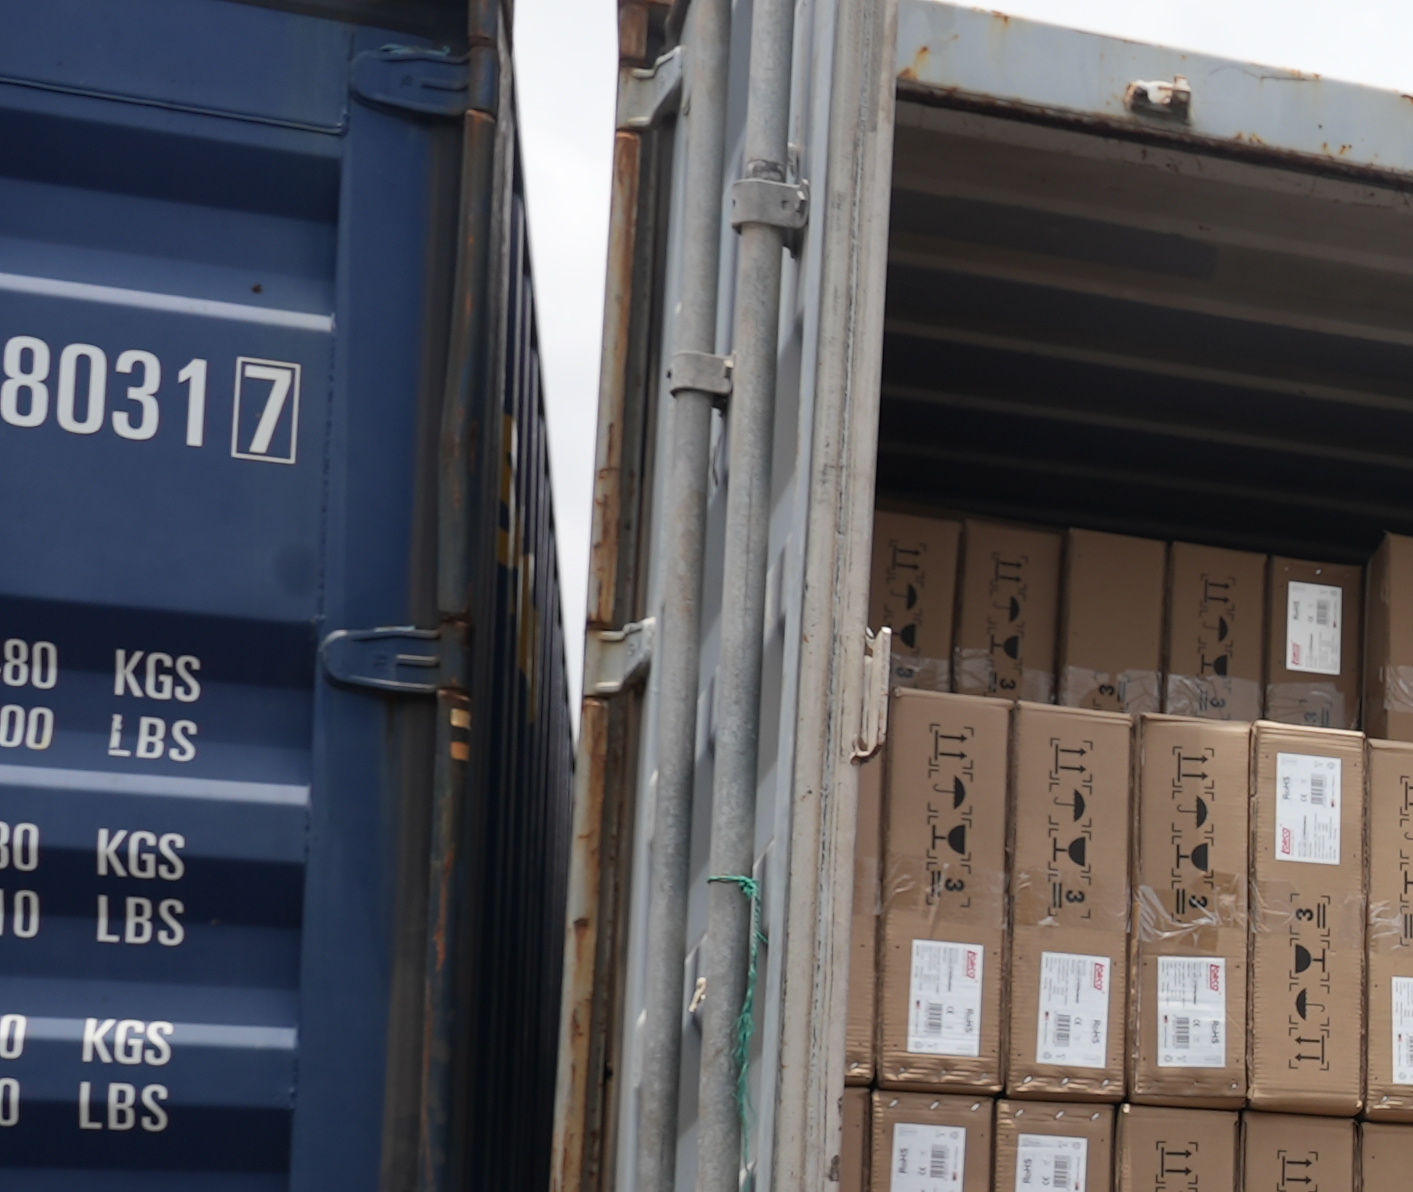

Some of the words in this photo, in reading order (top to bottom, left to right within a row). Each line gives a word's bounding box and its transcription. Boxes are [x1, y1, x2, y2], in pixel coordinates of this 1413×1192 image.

[114, 648, 201, 702] KGS
[108, 714, 198, 761] LBS
[97, 828, 186, 880] KGS
[96, 894, 185, 946] LBS
[82, 1018, 174, 1066] KGS
[78, 1081, 169, 1132] LBS
